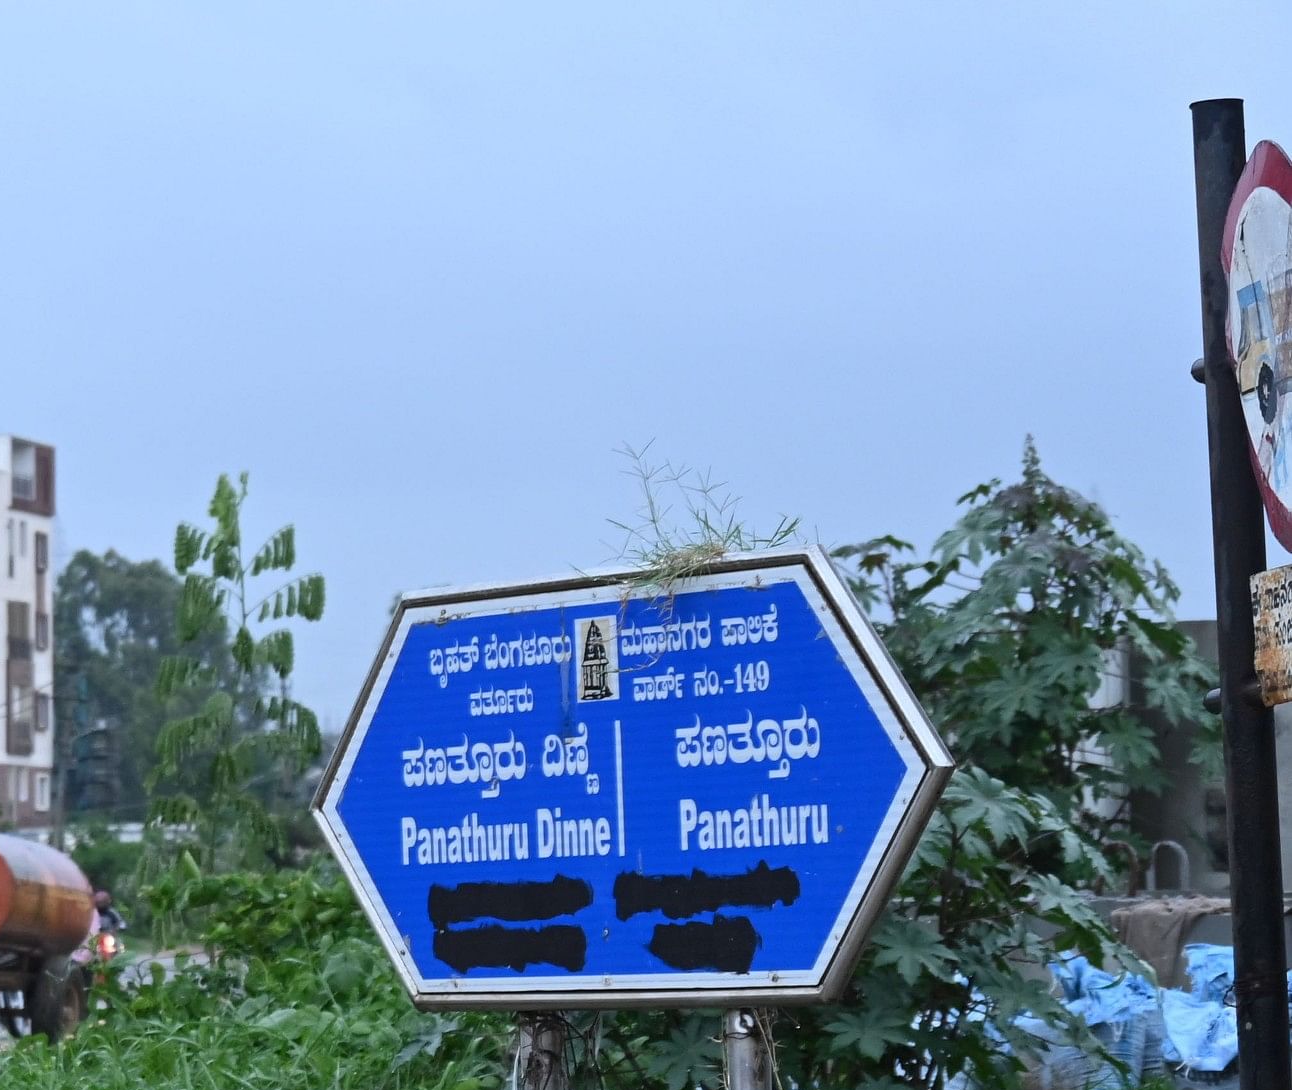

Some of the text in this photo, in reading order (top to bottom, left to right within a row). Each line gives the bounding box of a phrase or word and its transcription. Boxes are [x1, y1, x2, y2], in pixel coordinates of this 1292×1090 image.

[430, 603, 778, 688] ಬೃಹತ್ ಬೆಂಗಳೂರು ಮಹಾನಗರ ಪಾಲಿಕೆ
[633, 666, 685, 702] ವಾರ್ಡ್
[401, 730, 527, 799] ಪಣತ್ತೂರು
[675, 704, 821, 779] ಪಣತ್ತೂರು
[402, 807, 611, 866] Panathuru Dinne
[679, 793, 829, 852] Panathuru
